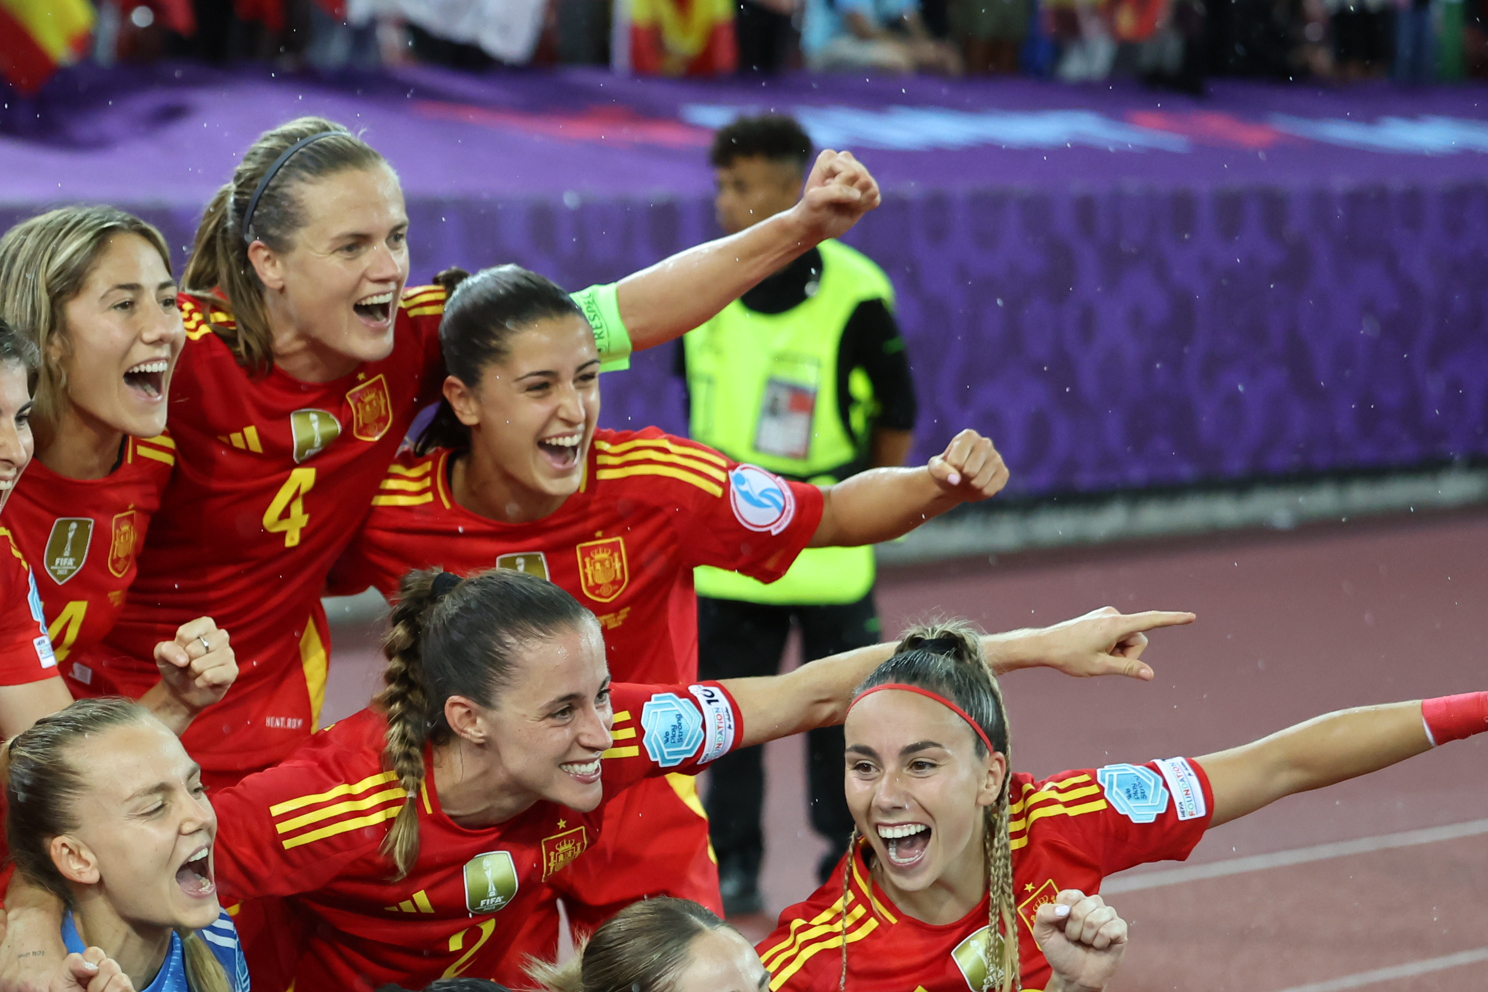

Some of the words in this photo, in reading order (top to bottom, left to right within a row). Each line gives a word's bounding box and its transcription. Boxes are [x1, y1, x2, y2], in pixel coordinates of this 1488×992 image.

[580, 292, 604, 340] RESPEC
[262, 467, 316, 547] 4
[1171, 762, 1196, 817] FOUNDATION
[480, 896, 503, 907] FIFA
[441, 918, 497, 979] 2
